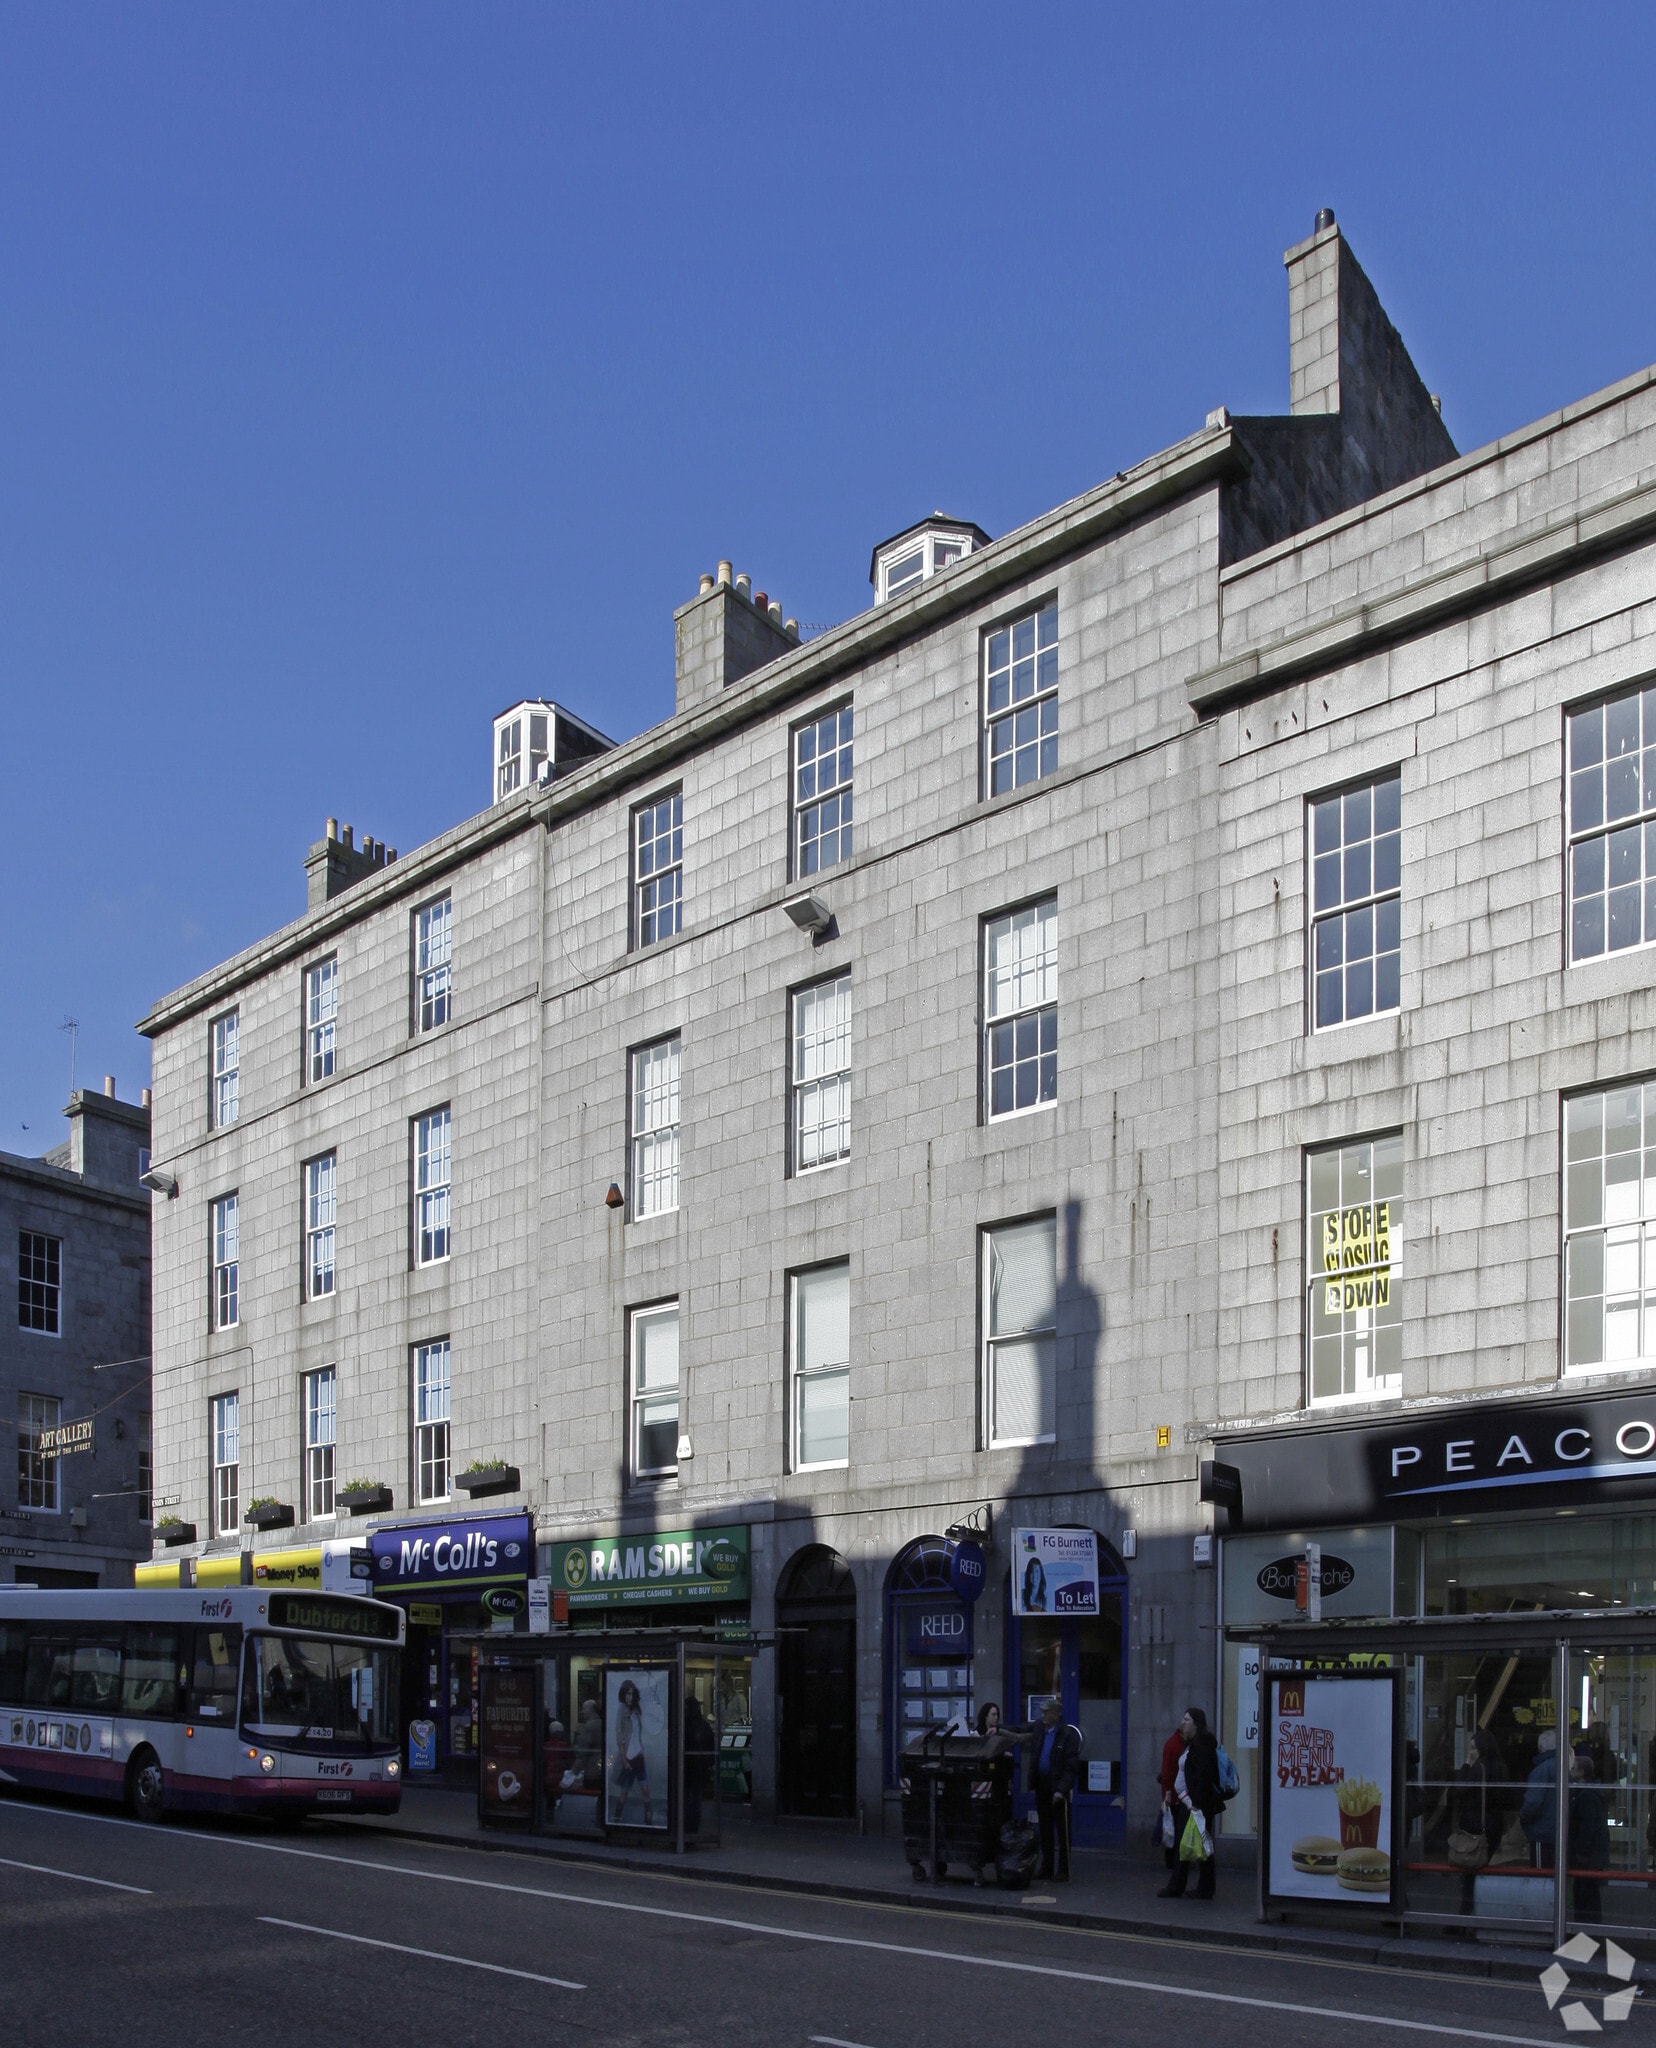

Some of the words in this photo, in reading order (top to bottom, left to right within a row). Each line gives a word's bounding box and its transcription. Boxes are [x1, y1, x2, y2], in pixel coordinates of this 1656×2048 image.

[1326, 1203, 1389, 1245] STORE
[1327, 1278, 1389, 1312] DOWN
[39, 1431, 55, 1449] ART
[1391, 1420, 1656, 1478] PEACO
[1043, 1535, 1056, 1548] FG
[1057, 1536, 1093, 1549] Burnett
[399, 1532, 498, 1575] McColl's
[590, 1538, 730, 1582] RAMSDEN
[712, 1554, 725, 1563] WE
[725, 1554, 739, 1564] BUY
[256, 1567, 267, 1578] The
[267, 1567, 296, 1583] Money
[297, 1564, 320, 1581] Shop
[716, 1562, 736, 1572] GOLD
[959, 1558, 982, 1577] REED
[569, 1592, 609, 1603] PAWNBROKERS
[622, 1590, 646, 1599] CHEQUE
[646, 1588, 673, 1599] CASHERS
[687, 1587, 698, 1596] WE
[698, 1586, 711, 1595] BUY
[710, 1585, 728, 1594] GOLD
[1059, 1591, 1073, 1604] To
[1077, 1591, 1095, 1604] Let
[201, 1599, 220, 1618] First
[286, 1600, 360, 1631] Dubford
[920, 1613, 965, 1637] REED
[486, 1706, 531, 1722] FAVOURITE
[1279, 1721, 1335, 1750] SAVER
[414, 1760, 430, 1768] here!
[415, 1752, 429, 1762] Play
[1278, 1743, 1334, 1768] MENU
[318, 1761, 340, 1775] First
[1307, 1767, 1345, 1786] EACH
